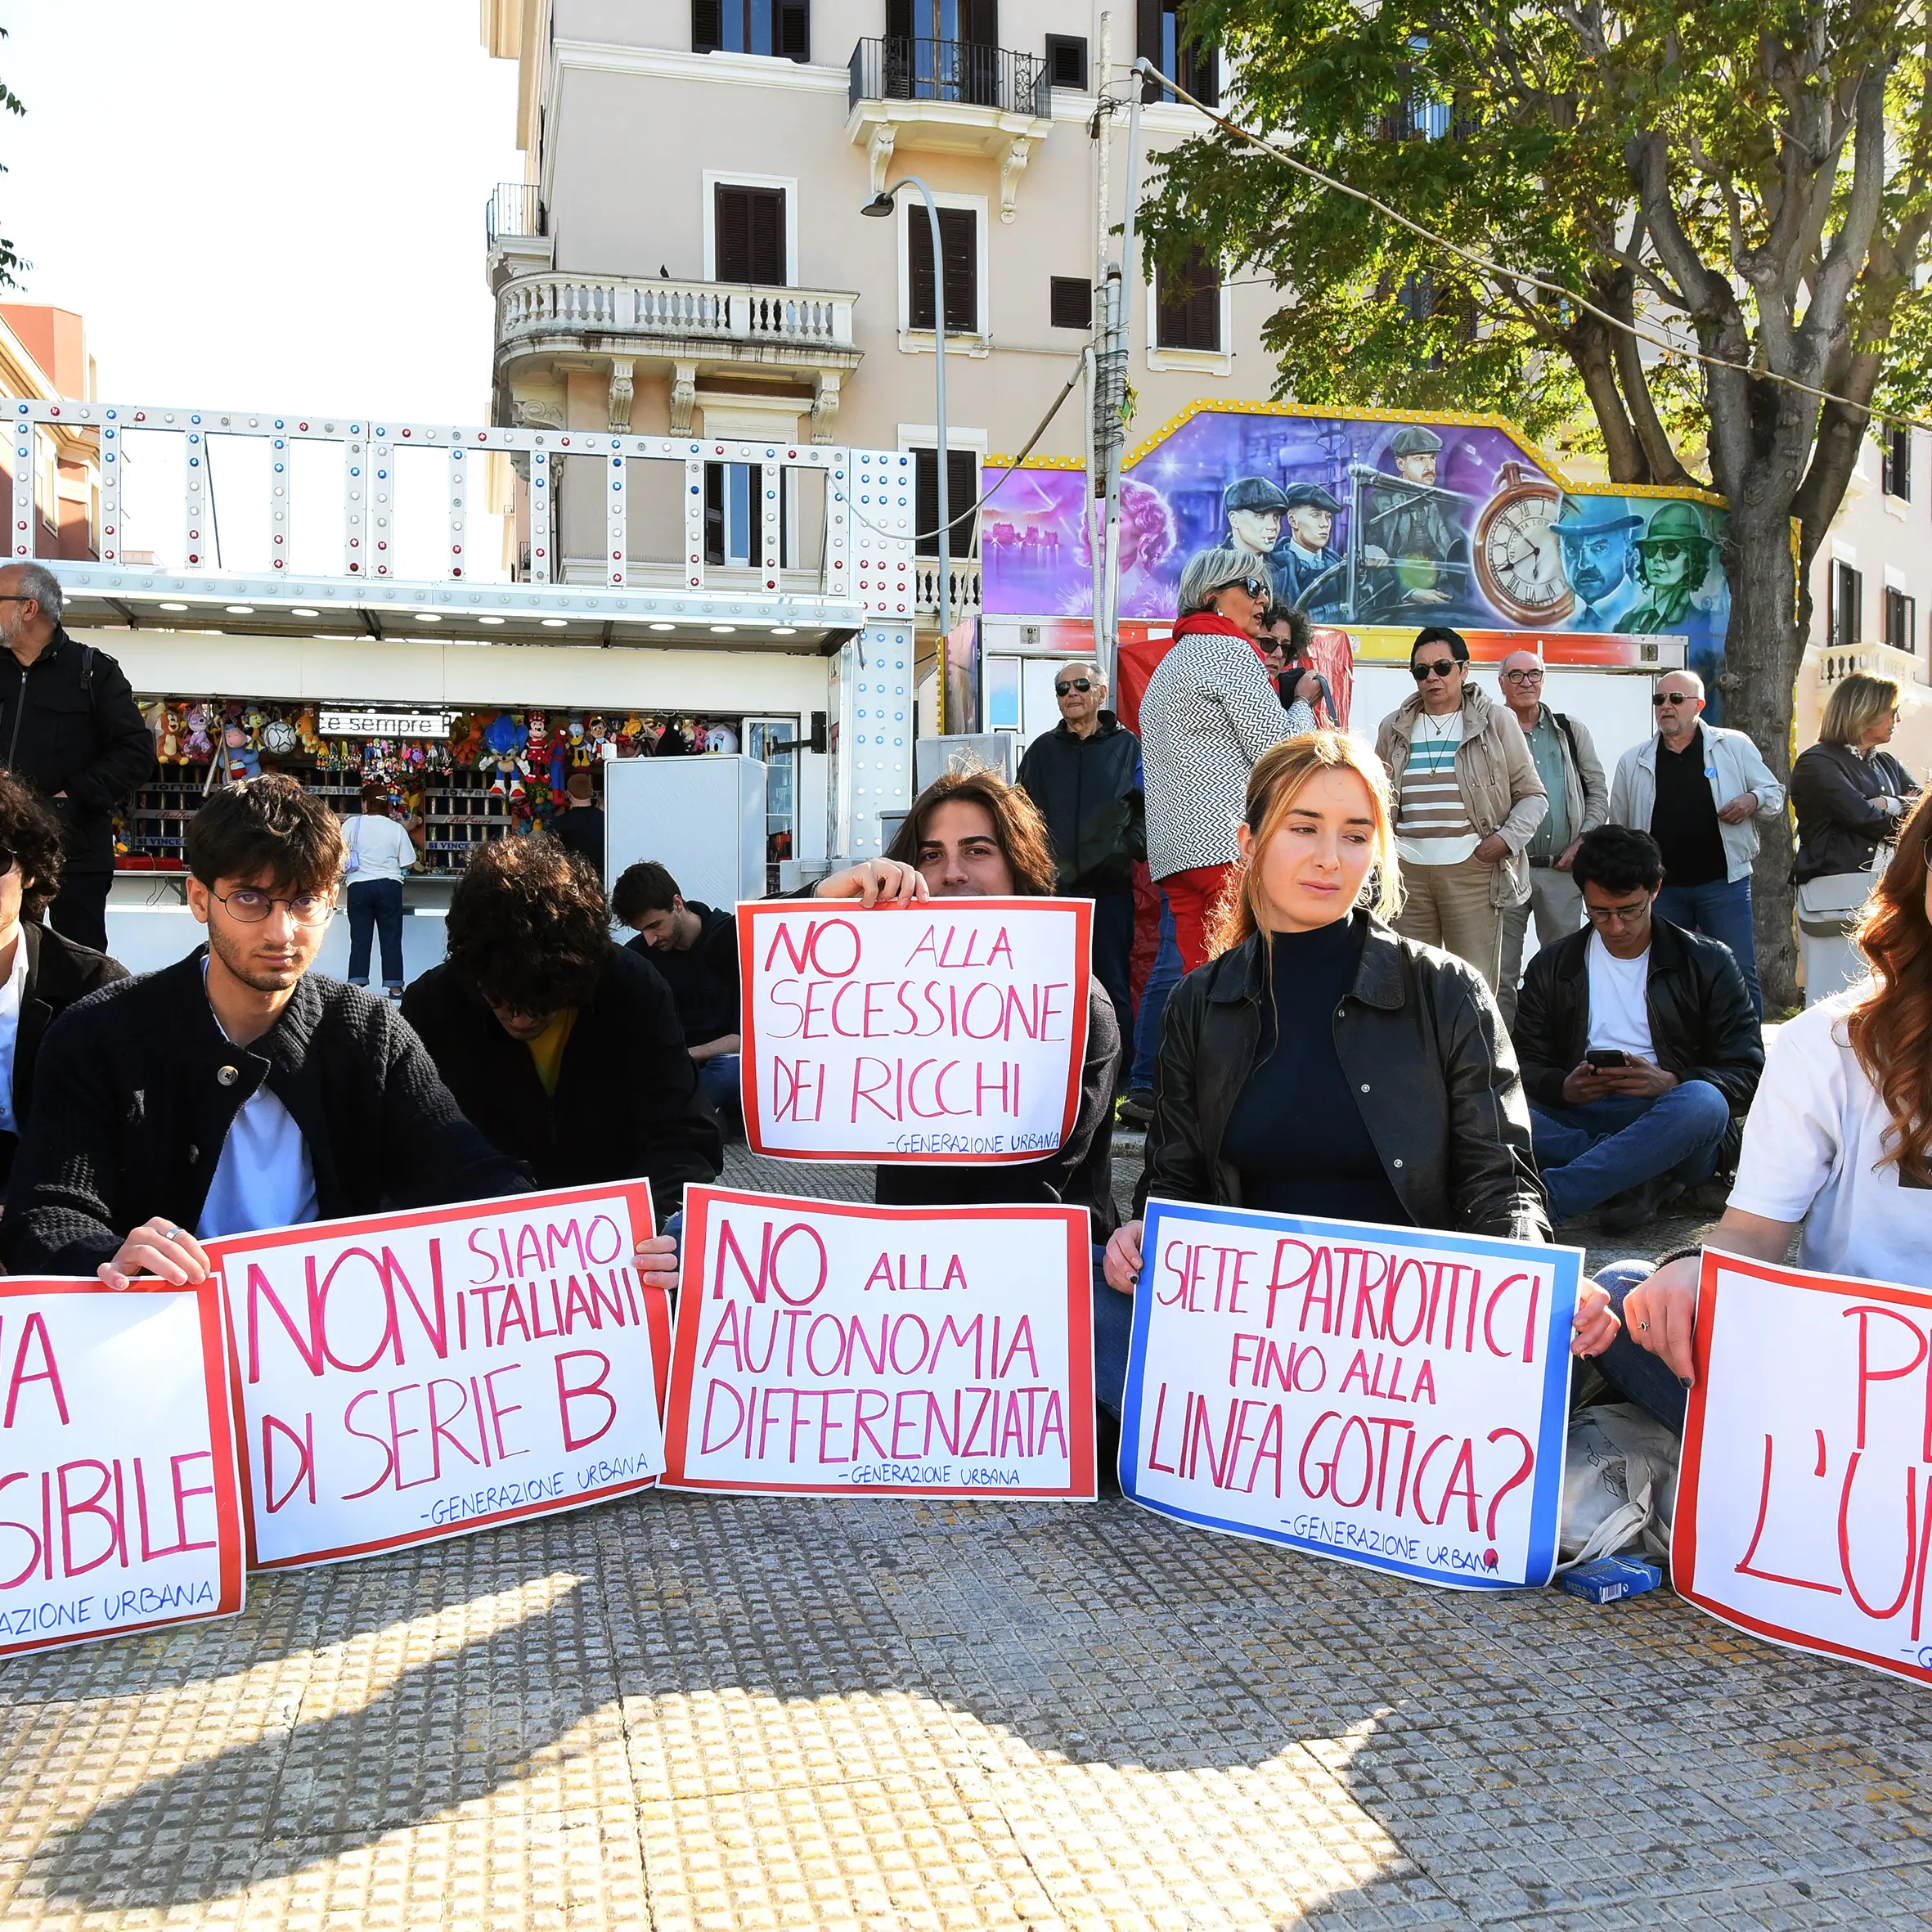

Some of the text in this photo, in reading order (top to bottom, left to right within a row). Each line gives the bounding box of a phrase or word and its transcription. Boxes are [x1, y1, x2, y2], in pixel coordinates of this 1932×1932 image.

[349, 717, 432, 738] sempre
[150, 838, 182, 846] VINCE
[428, 842, 438, 850] SI
[765, 919, 1014, 978] NO ALLA
[766, 978, 1070, 1042] SECESSIONE
[773, 1055, 1021, 1124] DEI RICCHI
[1010, 1132, 1060, 1151] URBANA
[712, 1220, 968, 1306] NO ALLA
[248, 1215, 622, 1384] NON SIAMO
[456, 1267, 640, 1351] ITALIANI
[1157, 1239, 1541, 1364] SIETE PATRIOTTICI
[0, 1311, 70, 1429] A
[702, 1299, 1040, 1380] AUTONOMIA
[1229, 1333, 1436, 1405] FINO ALLA
[1842, 1305, 1932, 1463] P
[262, 1350, 618, 1514] DI SERIE B
[700, 1377, 1068, 1464] DIFFERENZIATA
[576, 1453, 649, 1490] URBANA
[959, 1468, 1021, 1485] URBANA
[1148, 1382, 1535, 1565] LINEA GOTICA?
[1427, 1545, 1500, 1575] URBANA
[1733, 1428, 1932, 1642] L'U
[104, 1581, 213, 1622] URBANA
